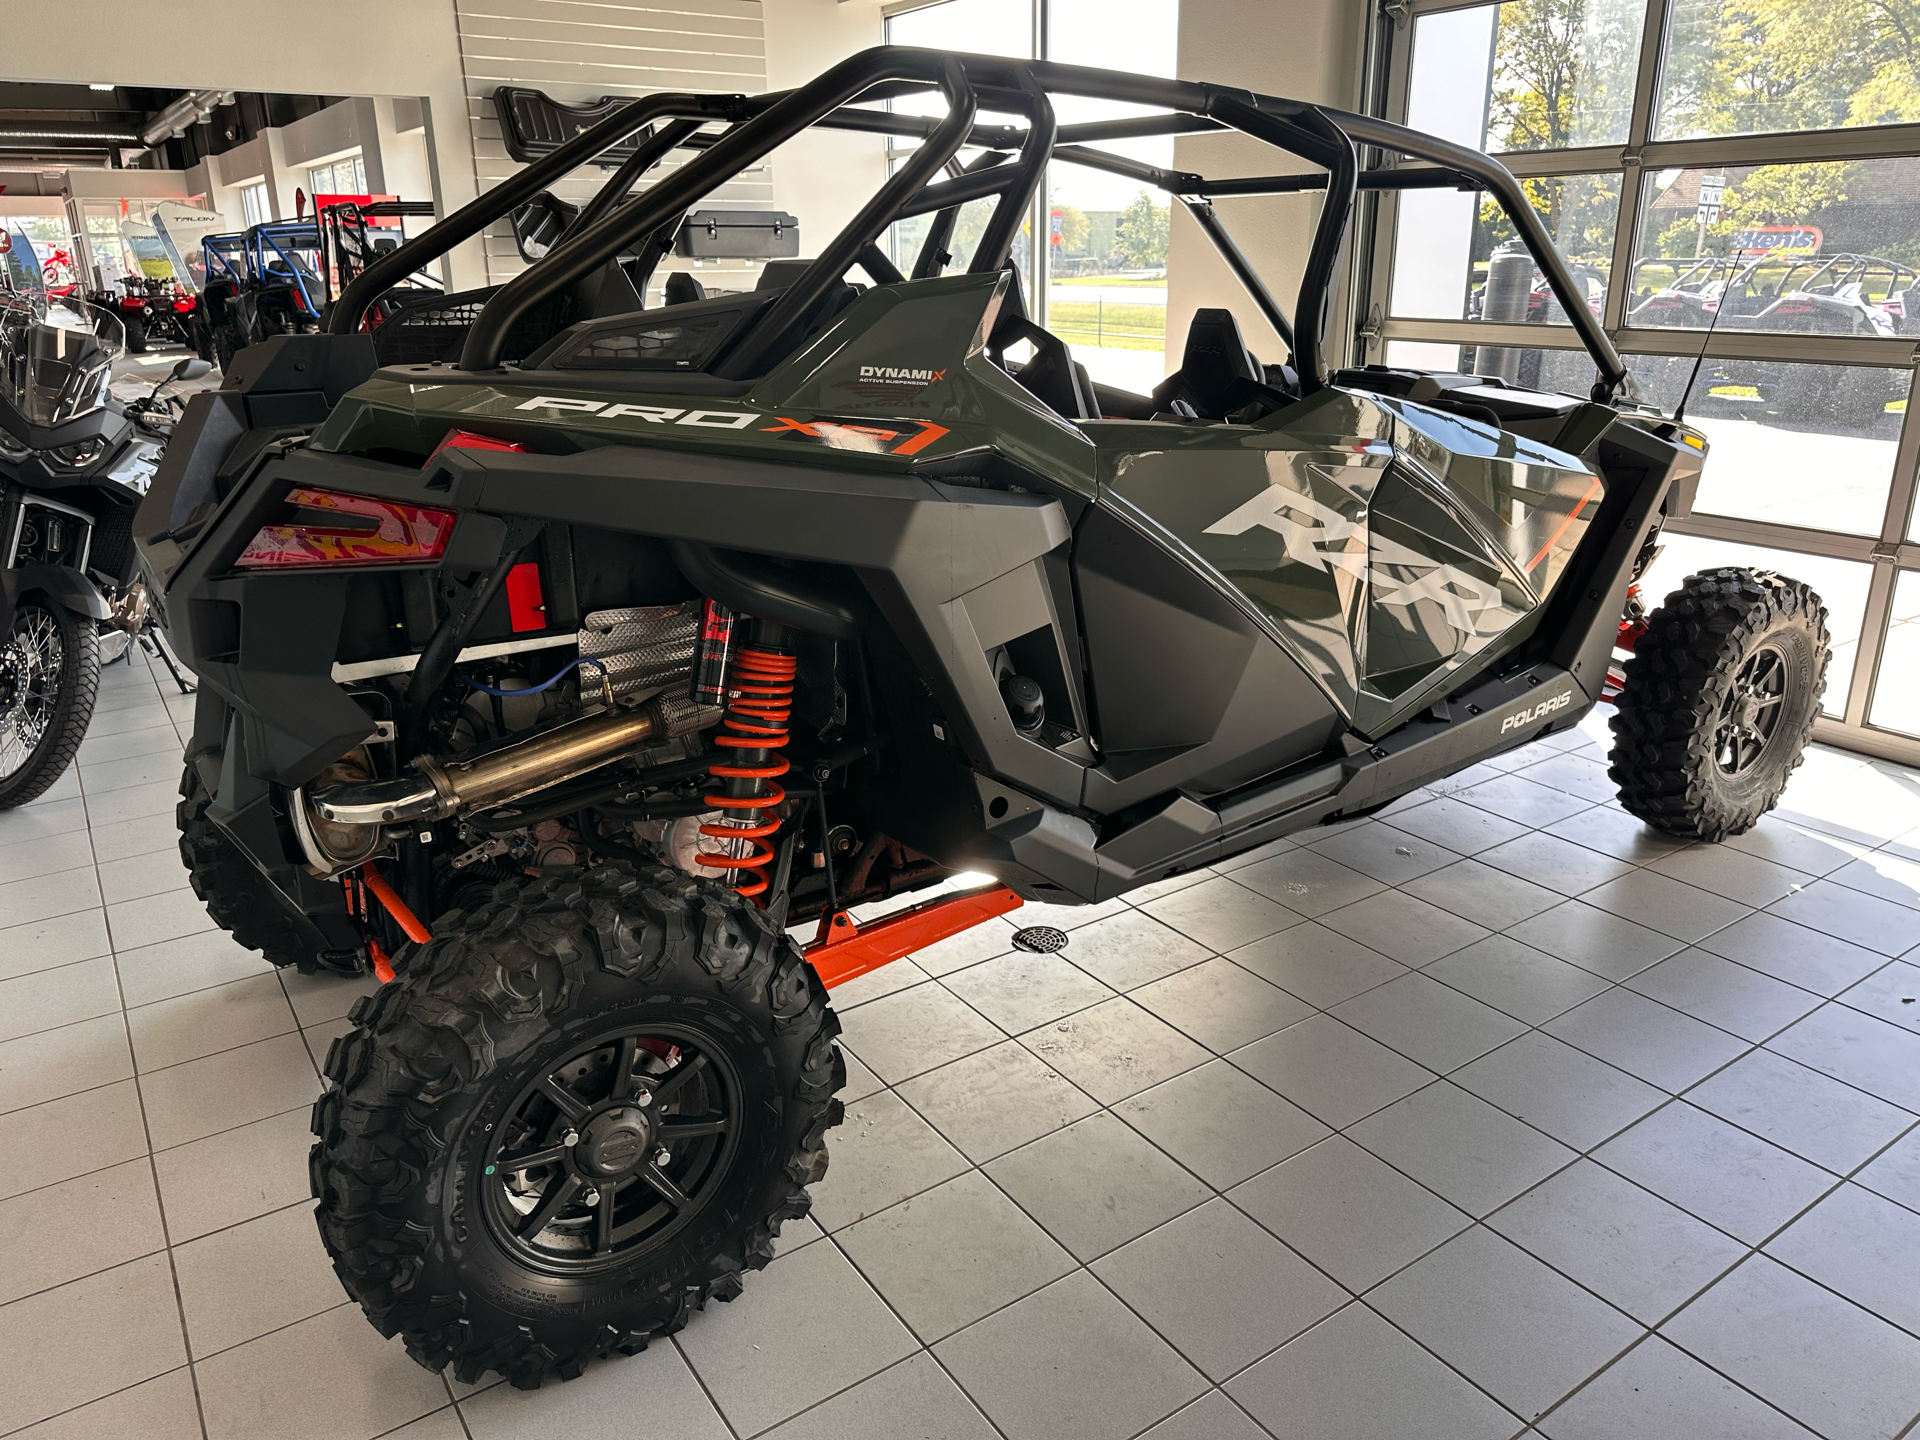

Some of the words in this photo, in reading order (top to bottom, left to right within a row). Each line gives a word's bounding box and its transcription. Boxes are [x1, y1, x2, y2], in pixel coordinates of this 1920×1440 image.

[1702, 192, 1709, 202] N
[1713, 193, 1720, 203] N
[860, 366, 947, 383] DYNAMIX
[514, 396, 761, 430] PRO
[1202, 482, 1503, 636] RZR
[1500, 690, 1572, 735] POLARIS
